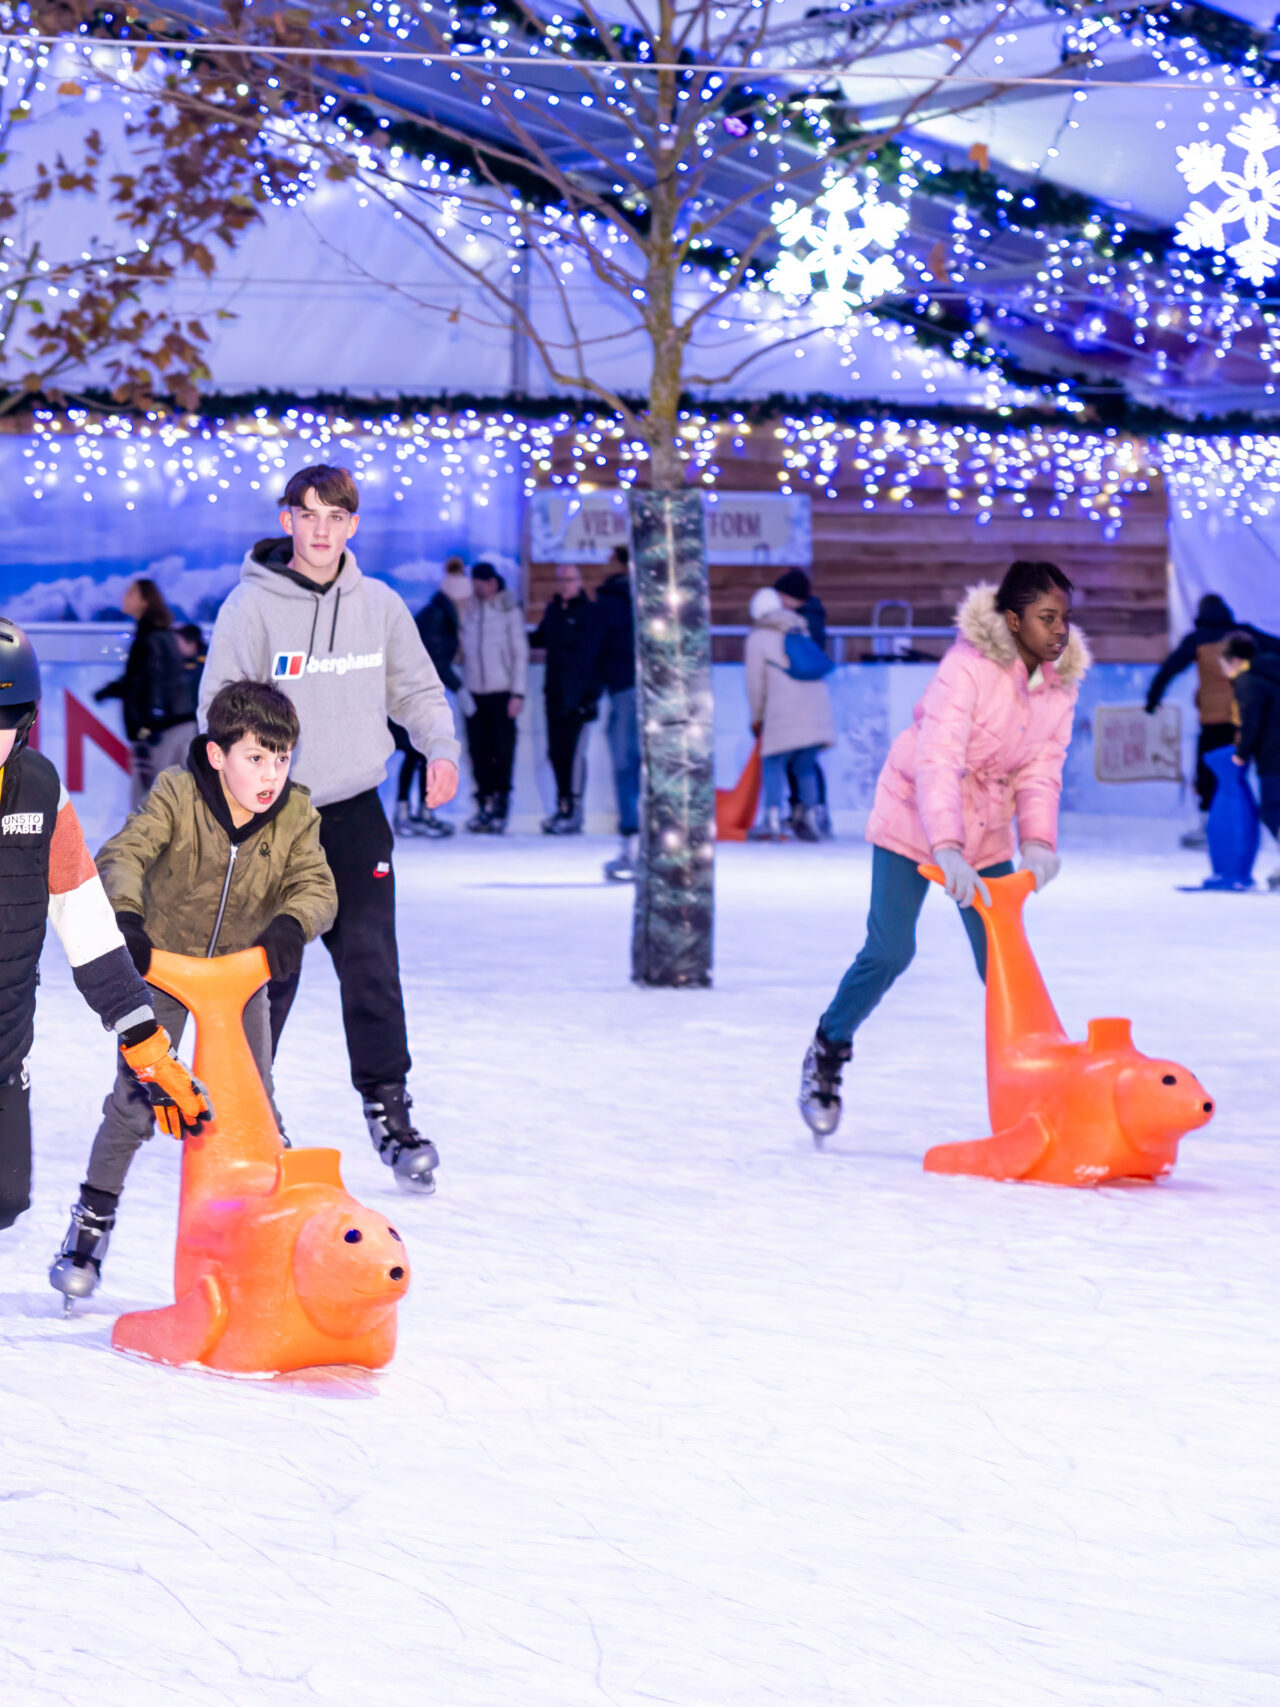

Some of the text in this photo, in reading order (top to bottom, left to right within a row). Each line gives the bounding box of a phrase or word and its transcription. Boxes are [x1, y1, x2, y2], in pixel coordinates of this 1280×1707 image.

[307, 653, 383, 675] berghaus
[3, 814, 41, 825] UNSTO
[3, 825, 42, 835] PPABLE
